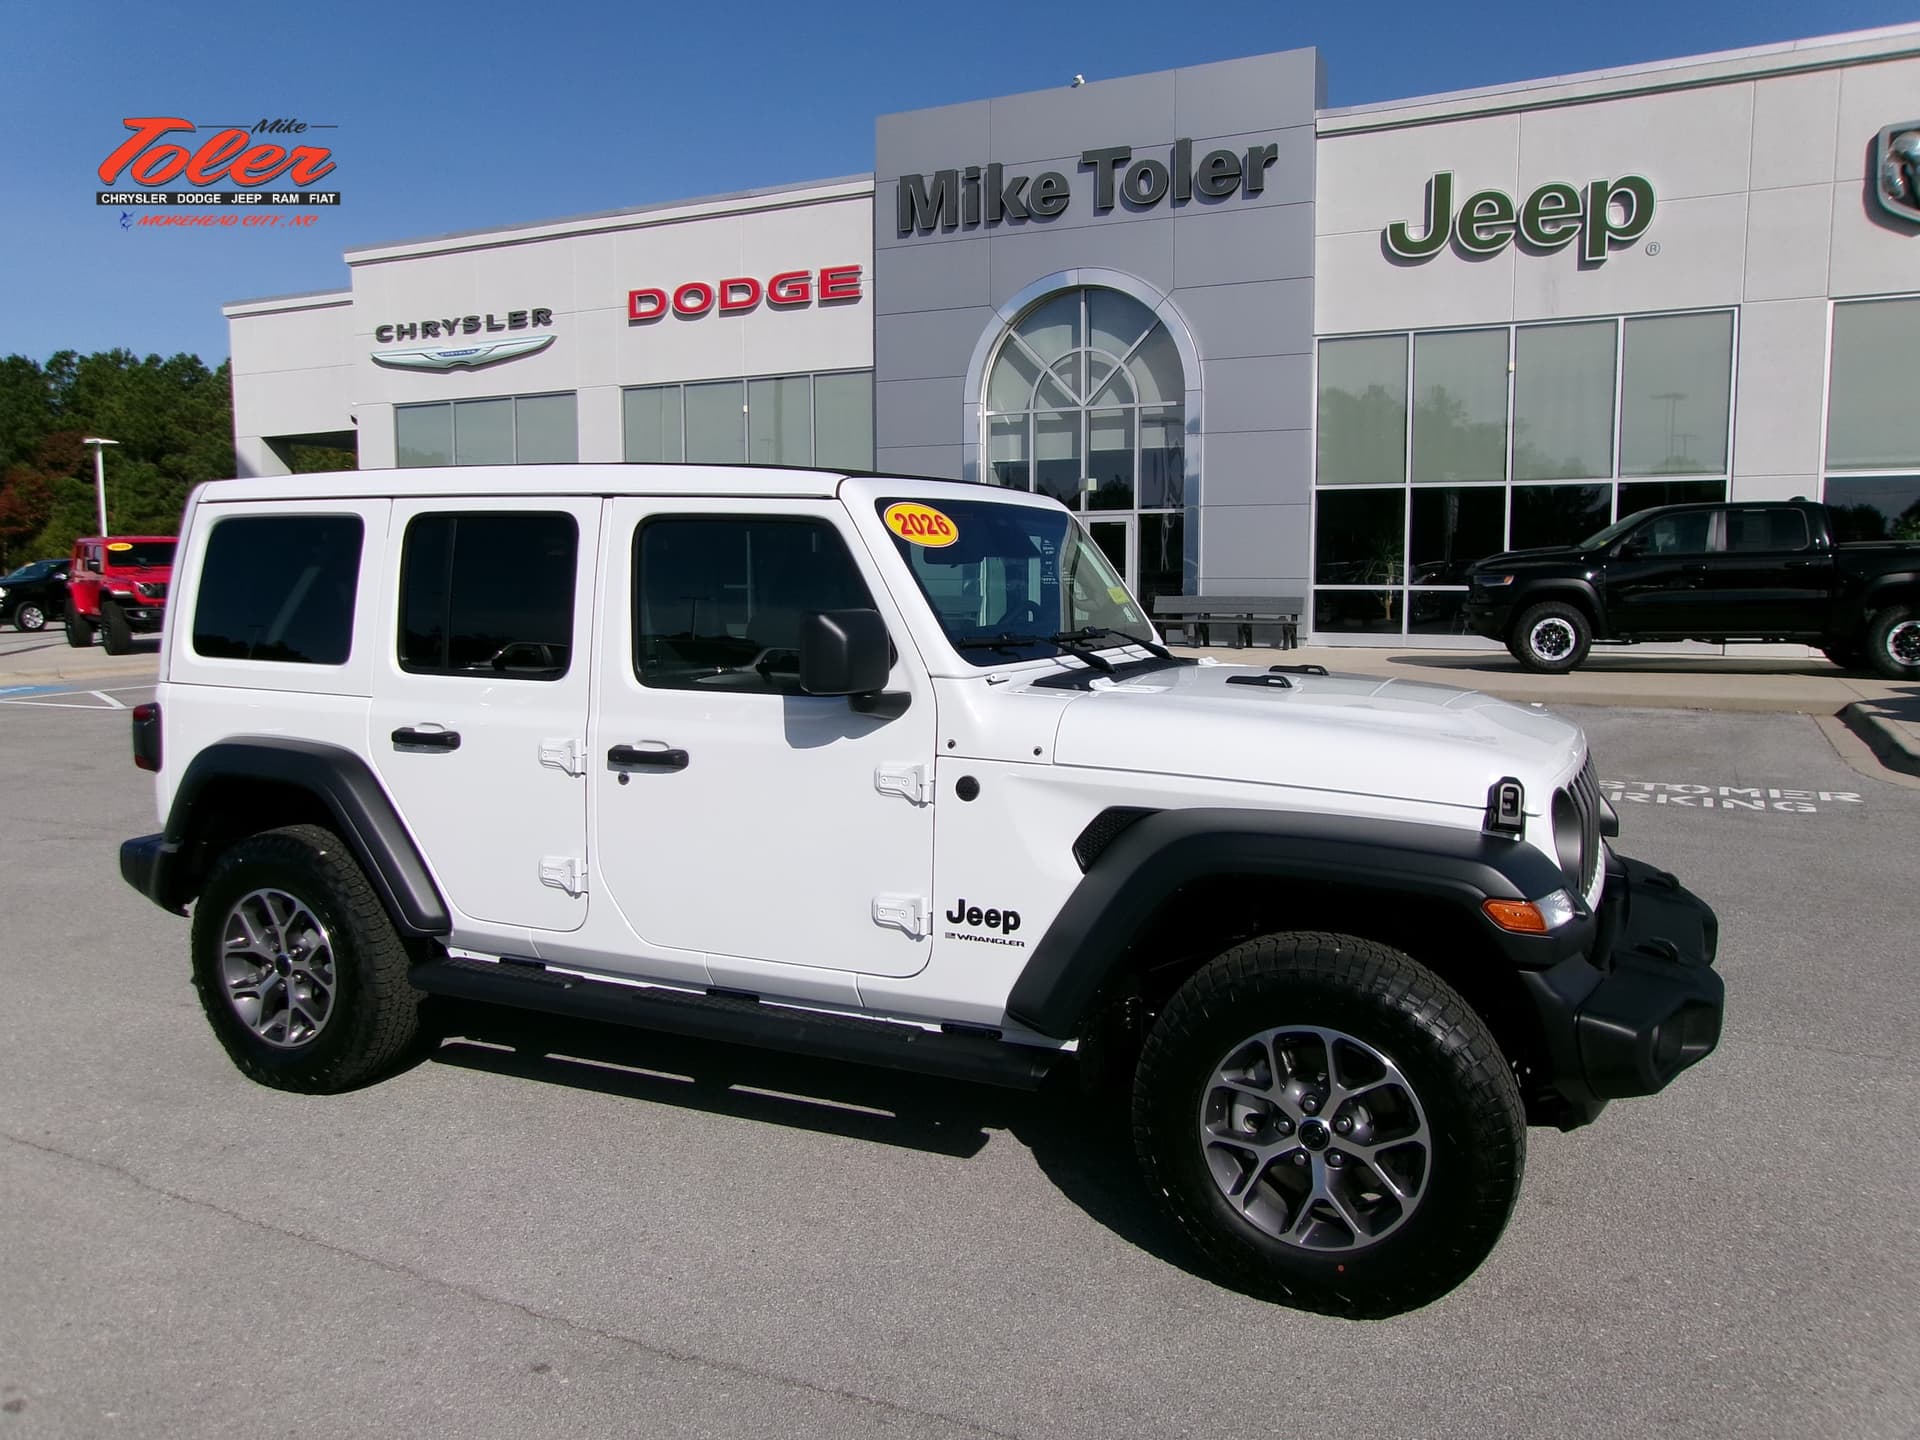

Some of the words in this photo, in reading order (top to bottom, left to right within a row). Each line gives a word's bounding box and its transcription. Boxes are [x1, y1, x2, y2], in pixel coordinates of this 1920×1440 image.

[898, 163, 1070, 232] Mike
[1080, 138, 1278, 209] Toler
[1386, 170, 1657, 262] Jeep
[628, 264, 863, 323] DODGE
[375, 307, 553, 343] CHRYSLER
[894, 512, 951, 536] 2026
[946, 898, 1021, 935] Jeep
[956, 932, 1025, 947] WRANGLER
